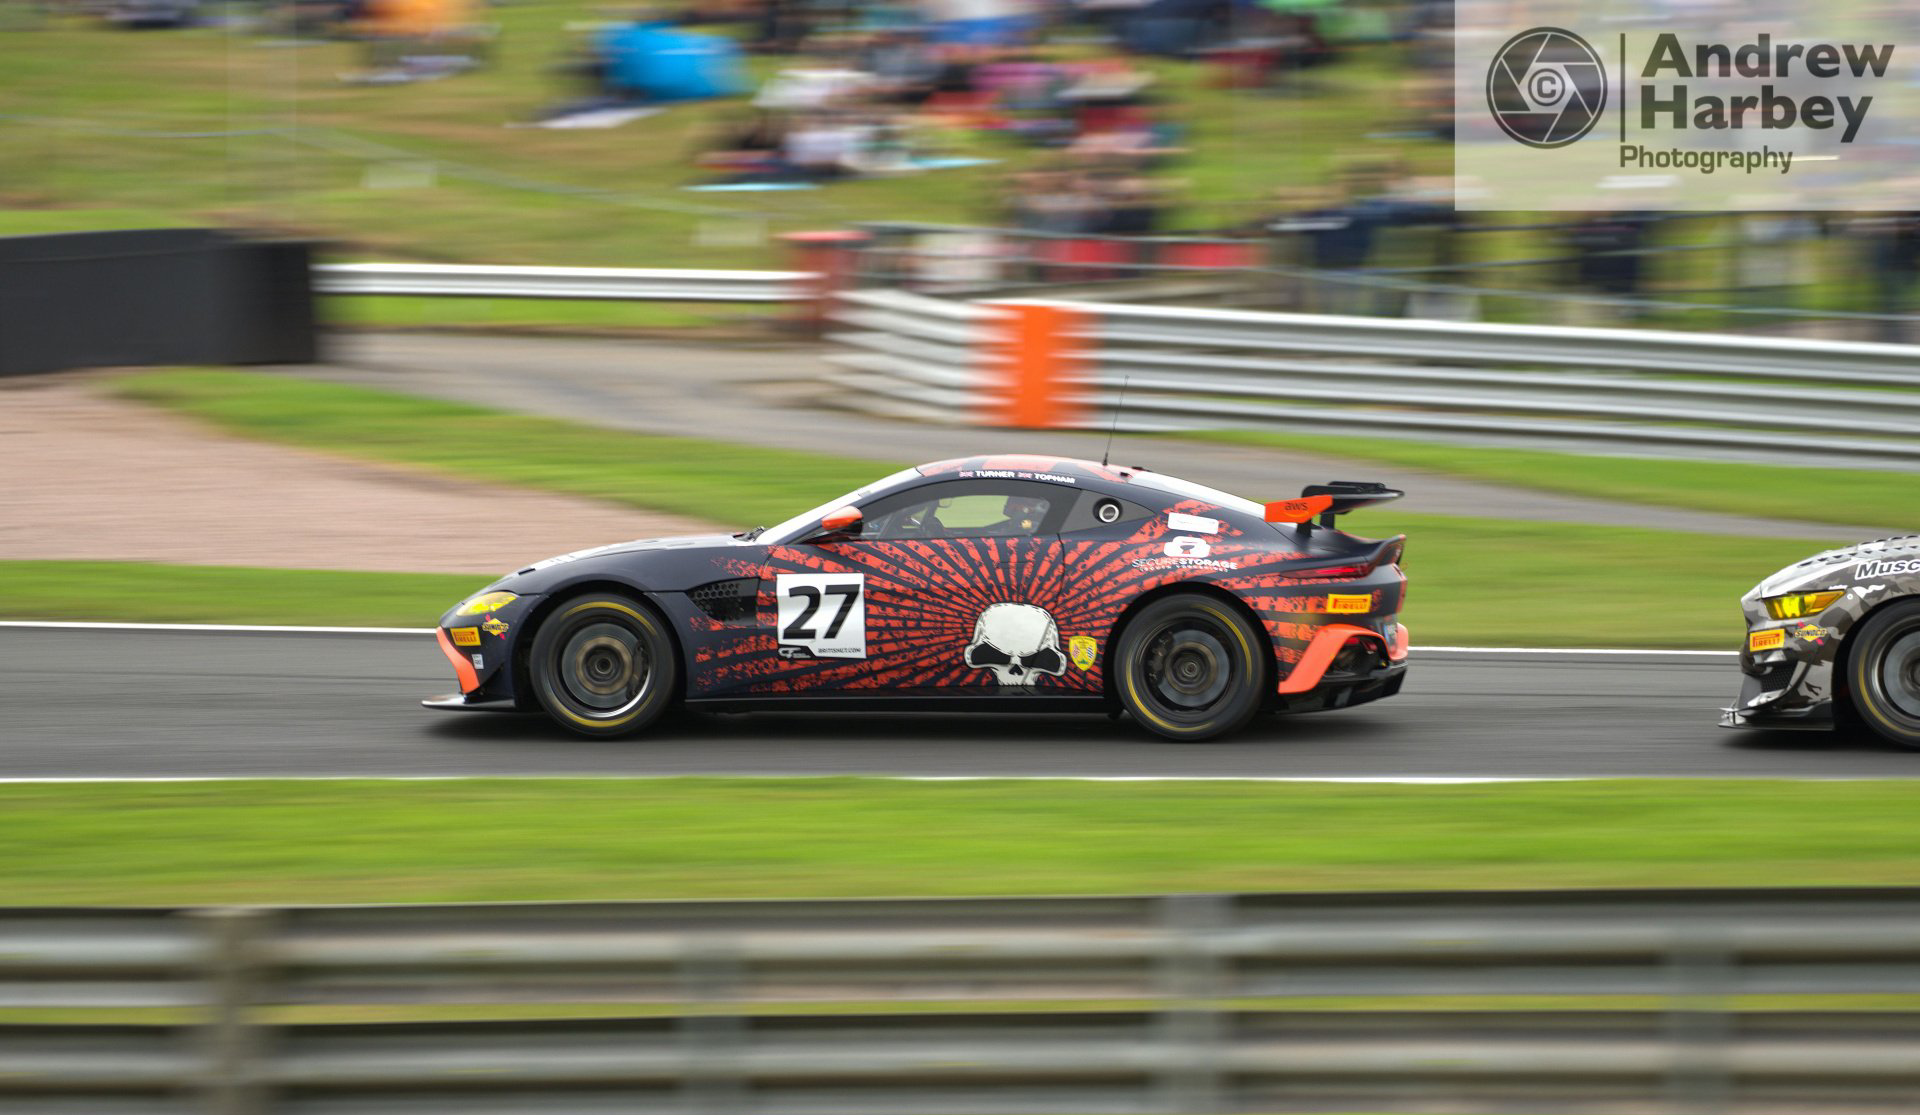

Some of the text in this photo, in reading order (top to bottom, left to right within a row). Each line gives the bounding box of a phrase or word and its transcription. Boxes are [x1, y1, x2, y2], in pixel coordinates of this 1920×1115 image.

[975, 470, 1076, 484] TURNER TOPHAM
[1284, 502, 1309, 511] aws
[1857, 560, 1920, 578] Musc
[1333, 598, 1368, 609] PIRELLI
[783, 584, 860, 639] 27
[1752, 632, 1781, 648] PIRELLI
[1795, 628, 1827, 638] SUNOCO
